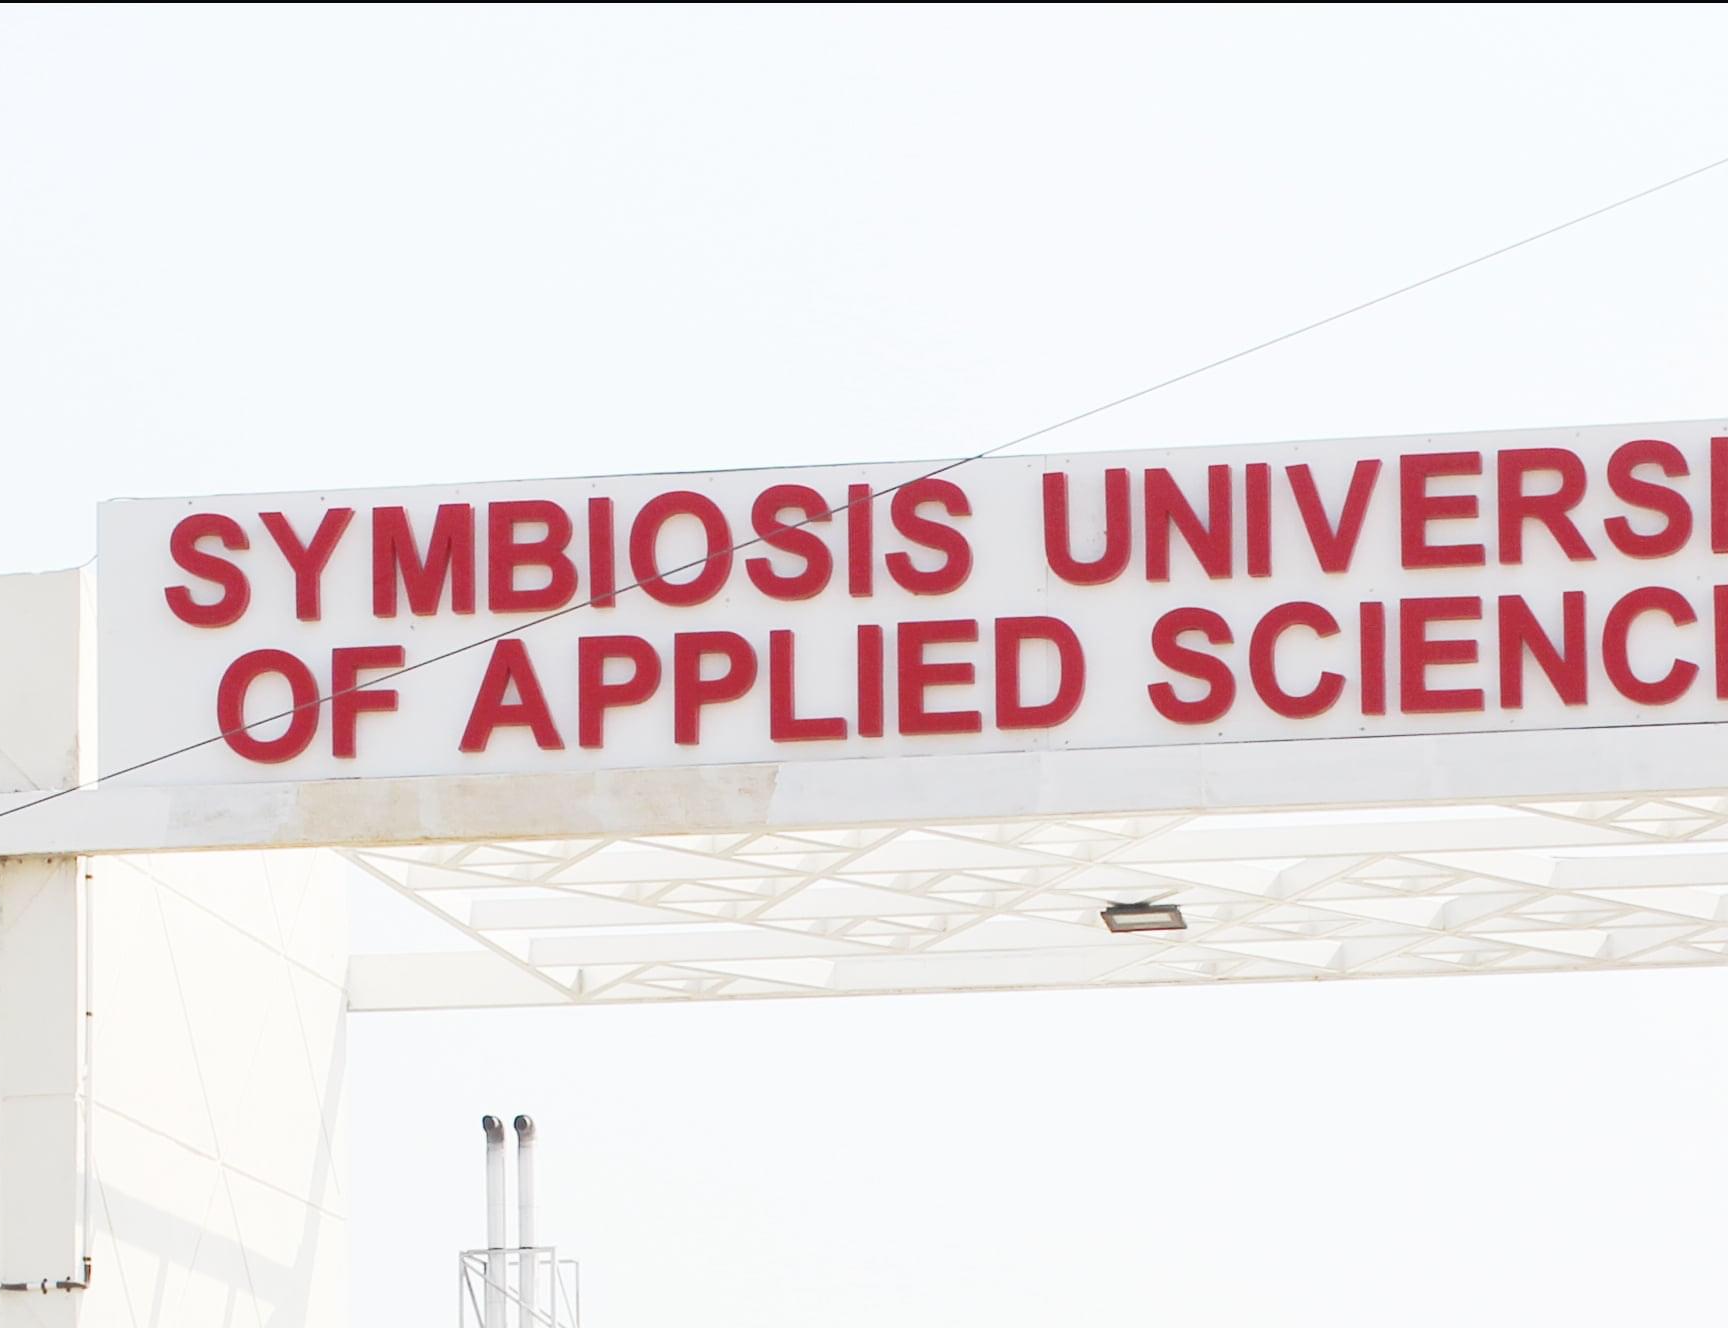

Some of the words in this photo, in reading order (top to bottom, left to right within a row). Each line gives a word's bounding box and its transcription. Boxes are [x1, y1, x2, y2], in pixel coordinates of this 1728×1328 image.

[165, 476, 973, 630] SYMBIOSIS
[217, 645, 405, 766] OF
[460, 616, 1086, 754] APPLIED
